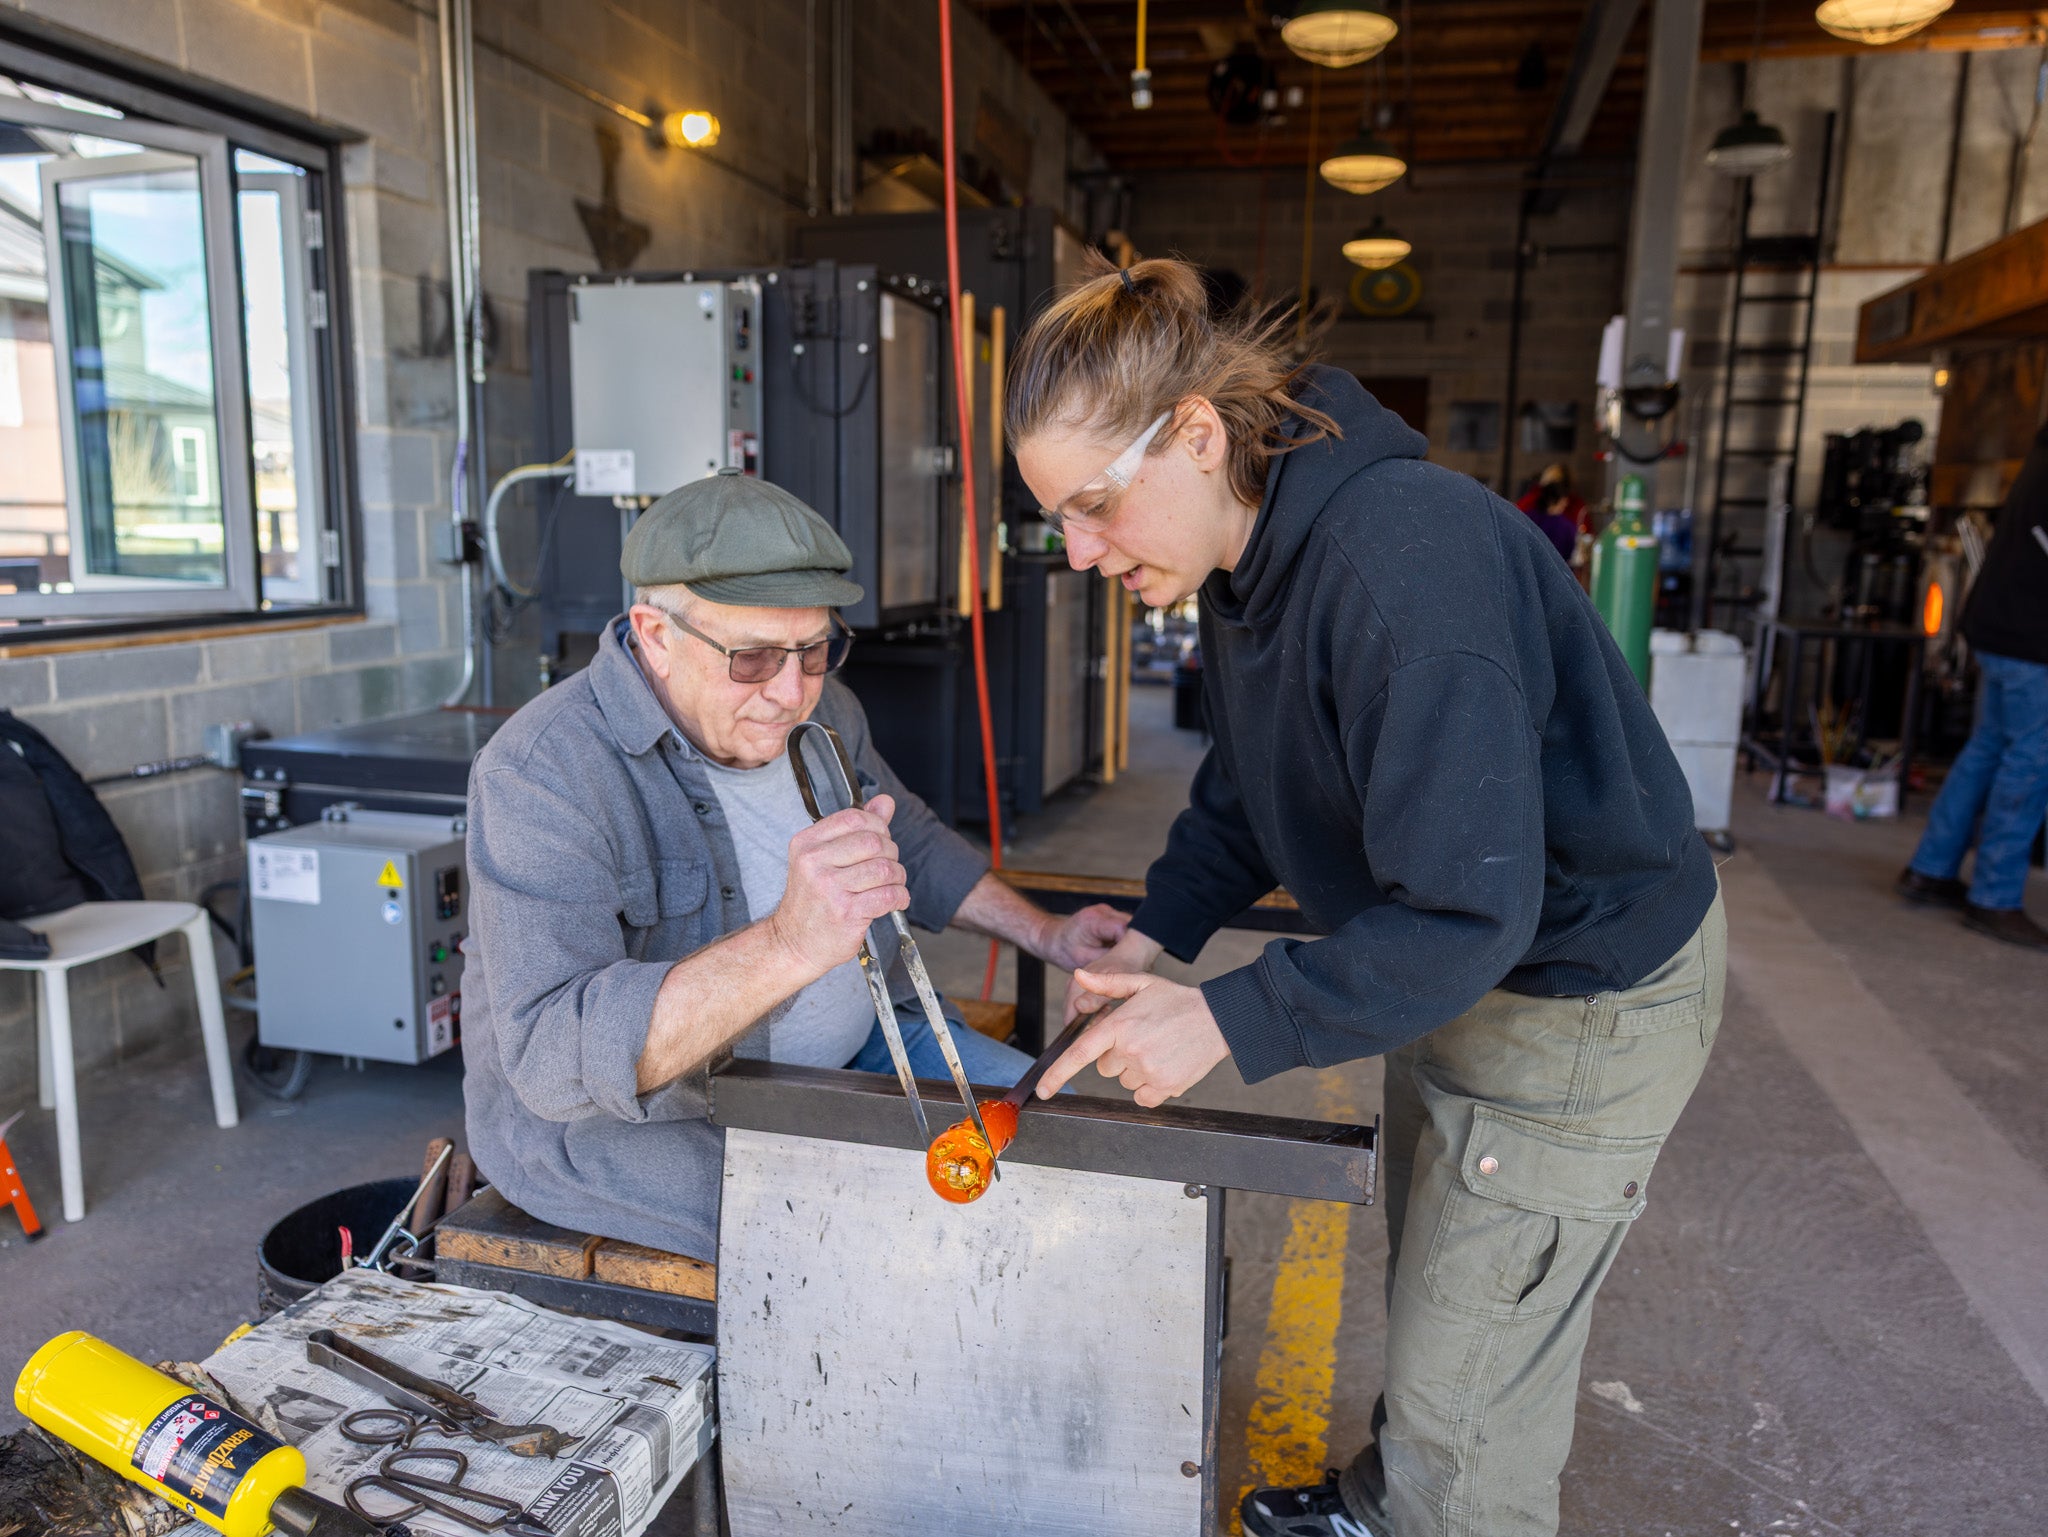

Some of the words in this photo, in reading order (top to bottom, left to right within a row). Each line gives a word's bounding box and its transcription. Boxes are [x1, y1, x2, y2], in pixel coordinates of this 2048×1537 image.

[160, 1403, 183, 1422] WEIGHT
[159, 1448, 174, 1477] DANGER
[190, 1428, 254, 1499] BERNZOMATIC
[530, 1489, 566, 1521] ANK
[552, 1466, 586, 1491] YOU
